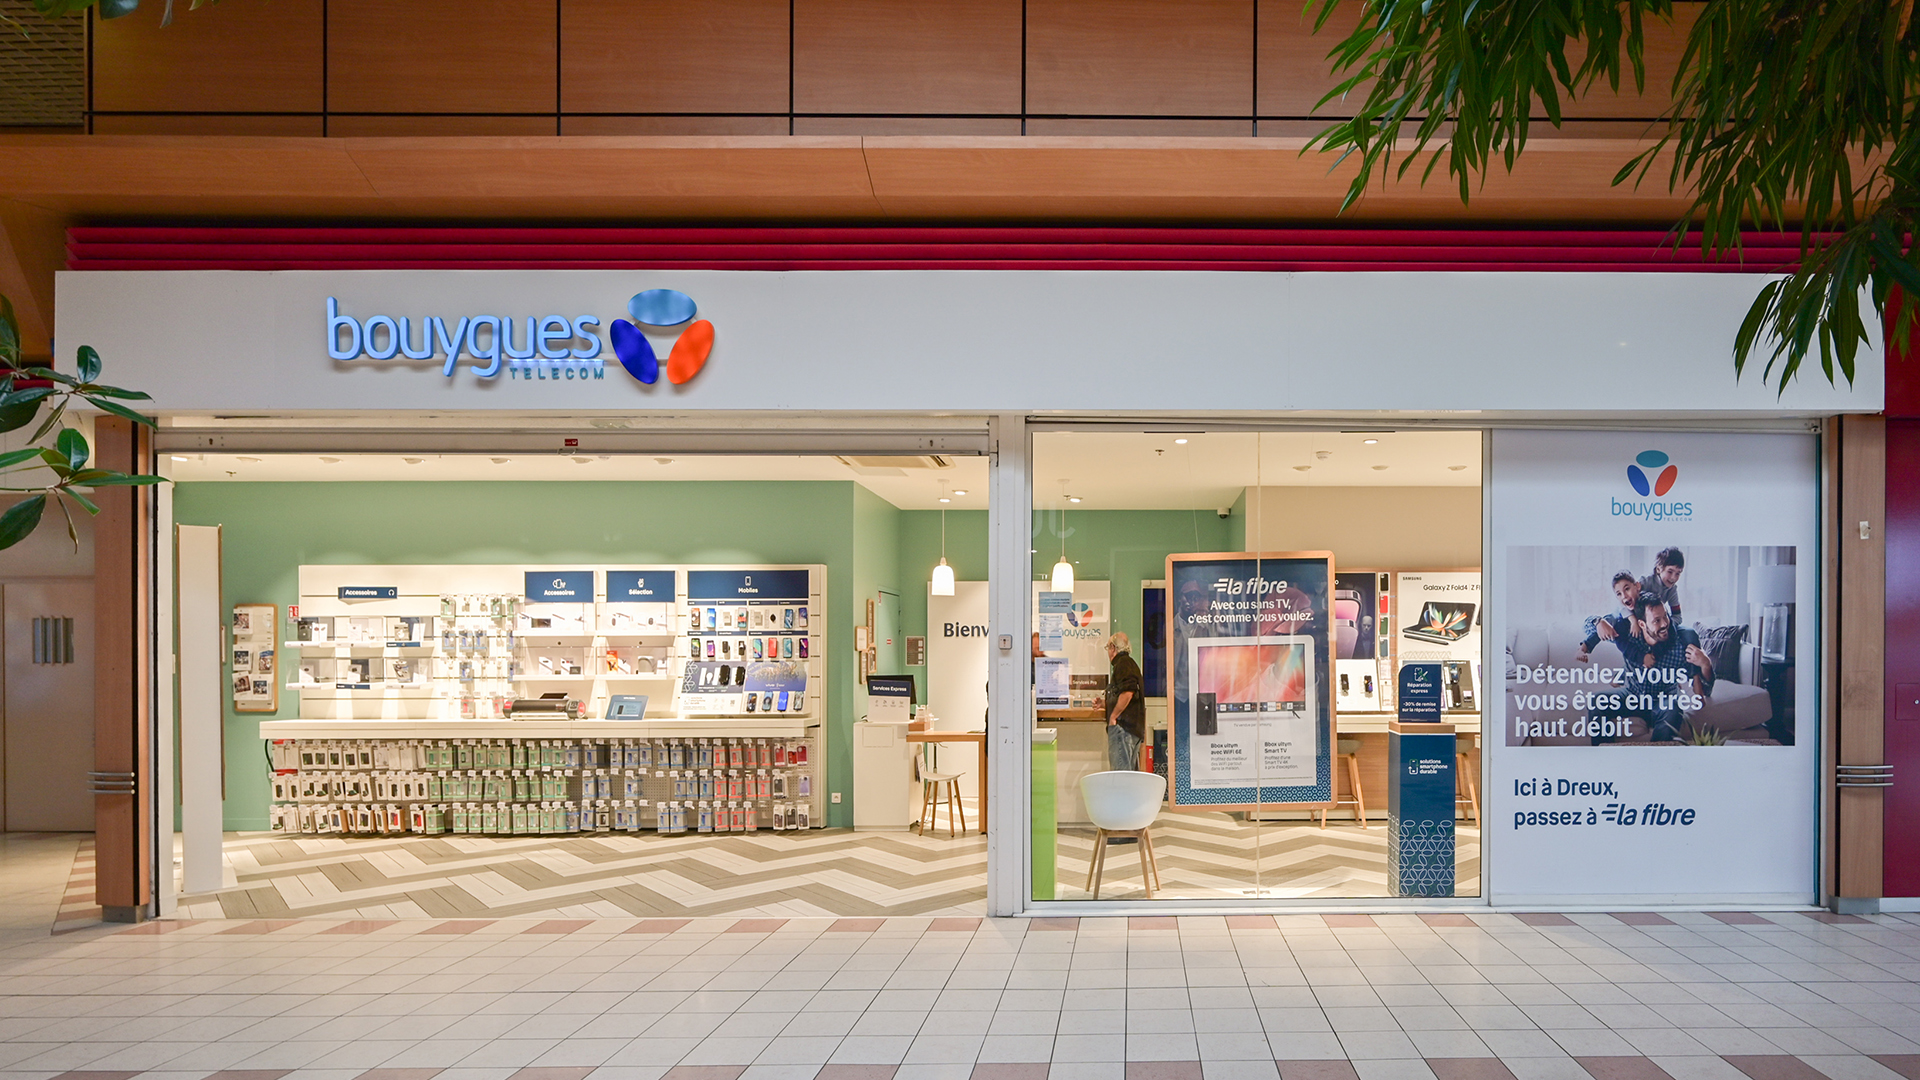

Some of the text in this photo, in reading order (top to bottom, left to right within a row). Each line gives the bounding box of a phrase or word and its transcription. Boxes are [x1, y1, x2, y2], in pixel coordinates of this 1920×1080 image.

[327, 296, 603, 377] bouygues
[510, 367, 605, 380] TELECOM
[1611, 496, 1693, 521] bouygues
[1226, 577, 1288, 595] la fibre
[1210, 598, 1291, 610] Avec ou sans TV,
[1187, 610, 1314, 624] c'est comme vous voulez.
[1516, 663, 1693, 687] Détendez-vous,
[1514, 690, 1703, 711] vous êtes en très
[1514, 715, 1634, 738] haut débit
[1514, 777, 1619, 799] Ici à Dreux,
[1514, 803, 1696, 830] passez à la fibre
